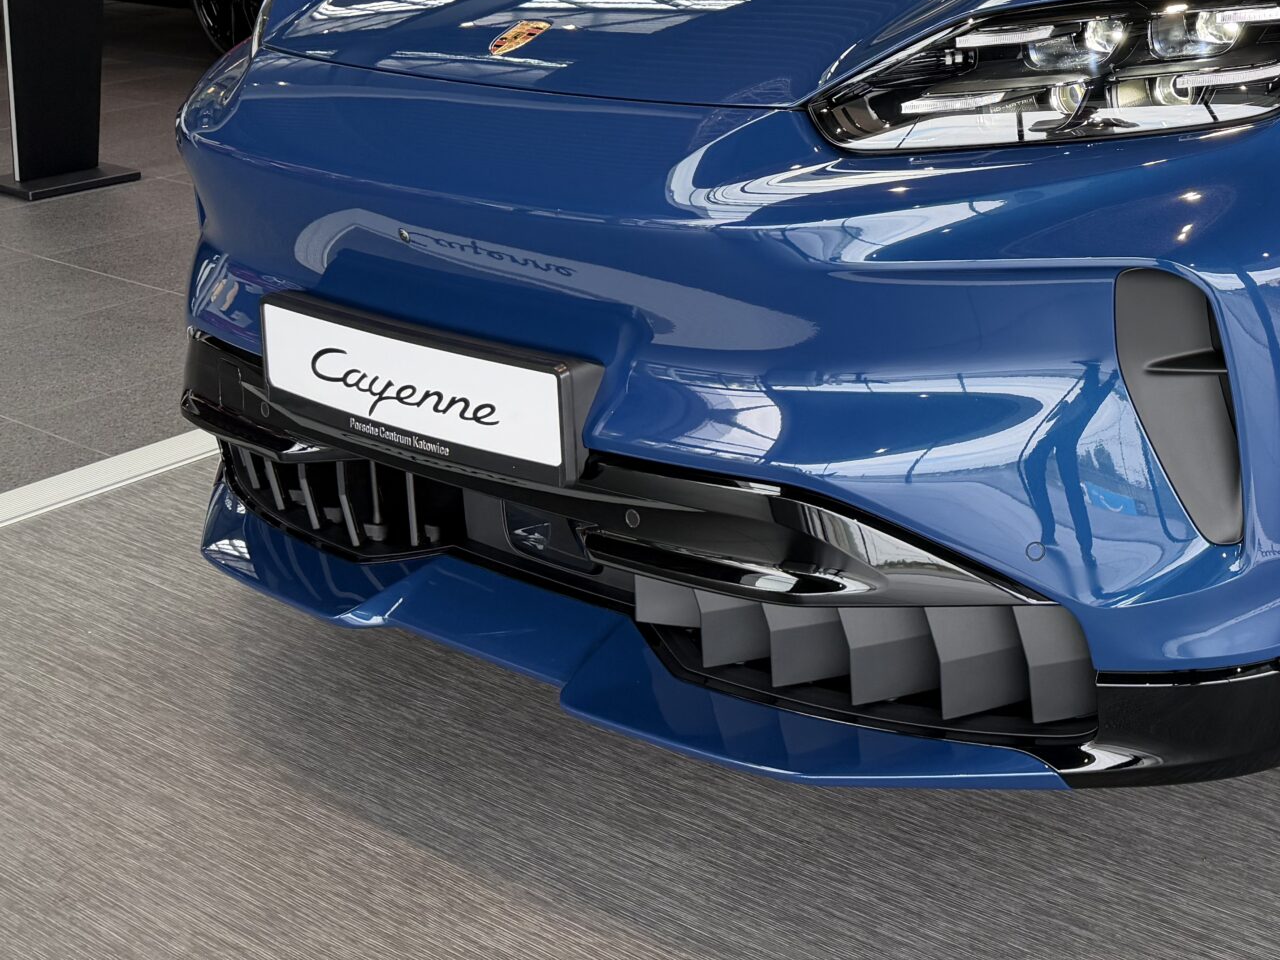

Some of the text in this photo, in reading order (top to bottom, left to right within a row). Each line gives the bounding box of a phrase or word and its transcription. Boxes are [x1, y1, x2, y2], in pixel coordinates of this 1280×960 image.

[310, 346, 500, 427] Cayenne
[349, 417, 450, 457] Porsche Centrum Katowice
